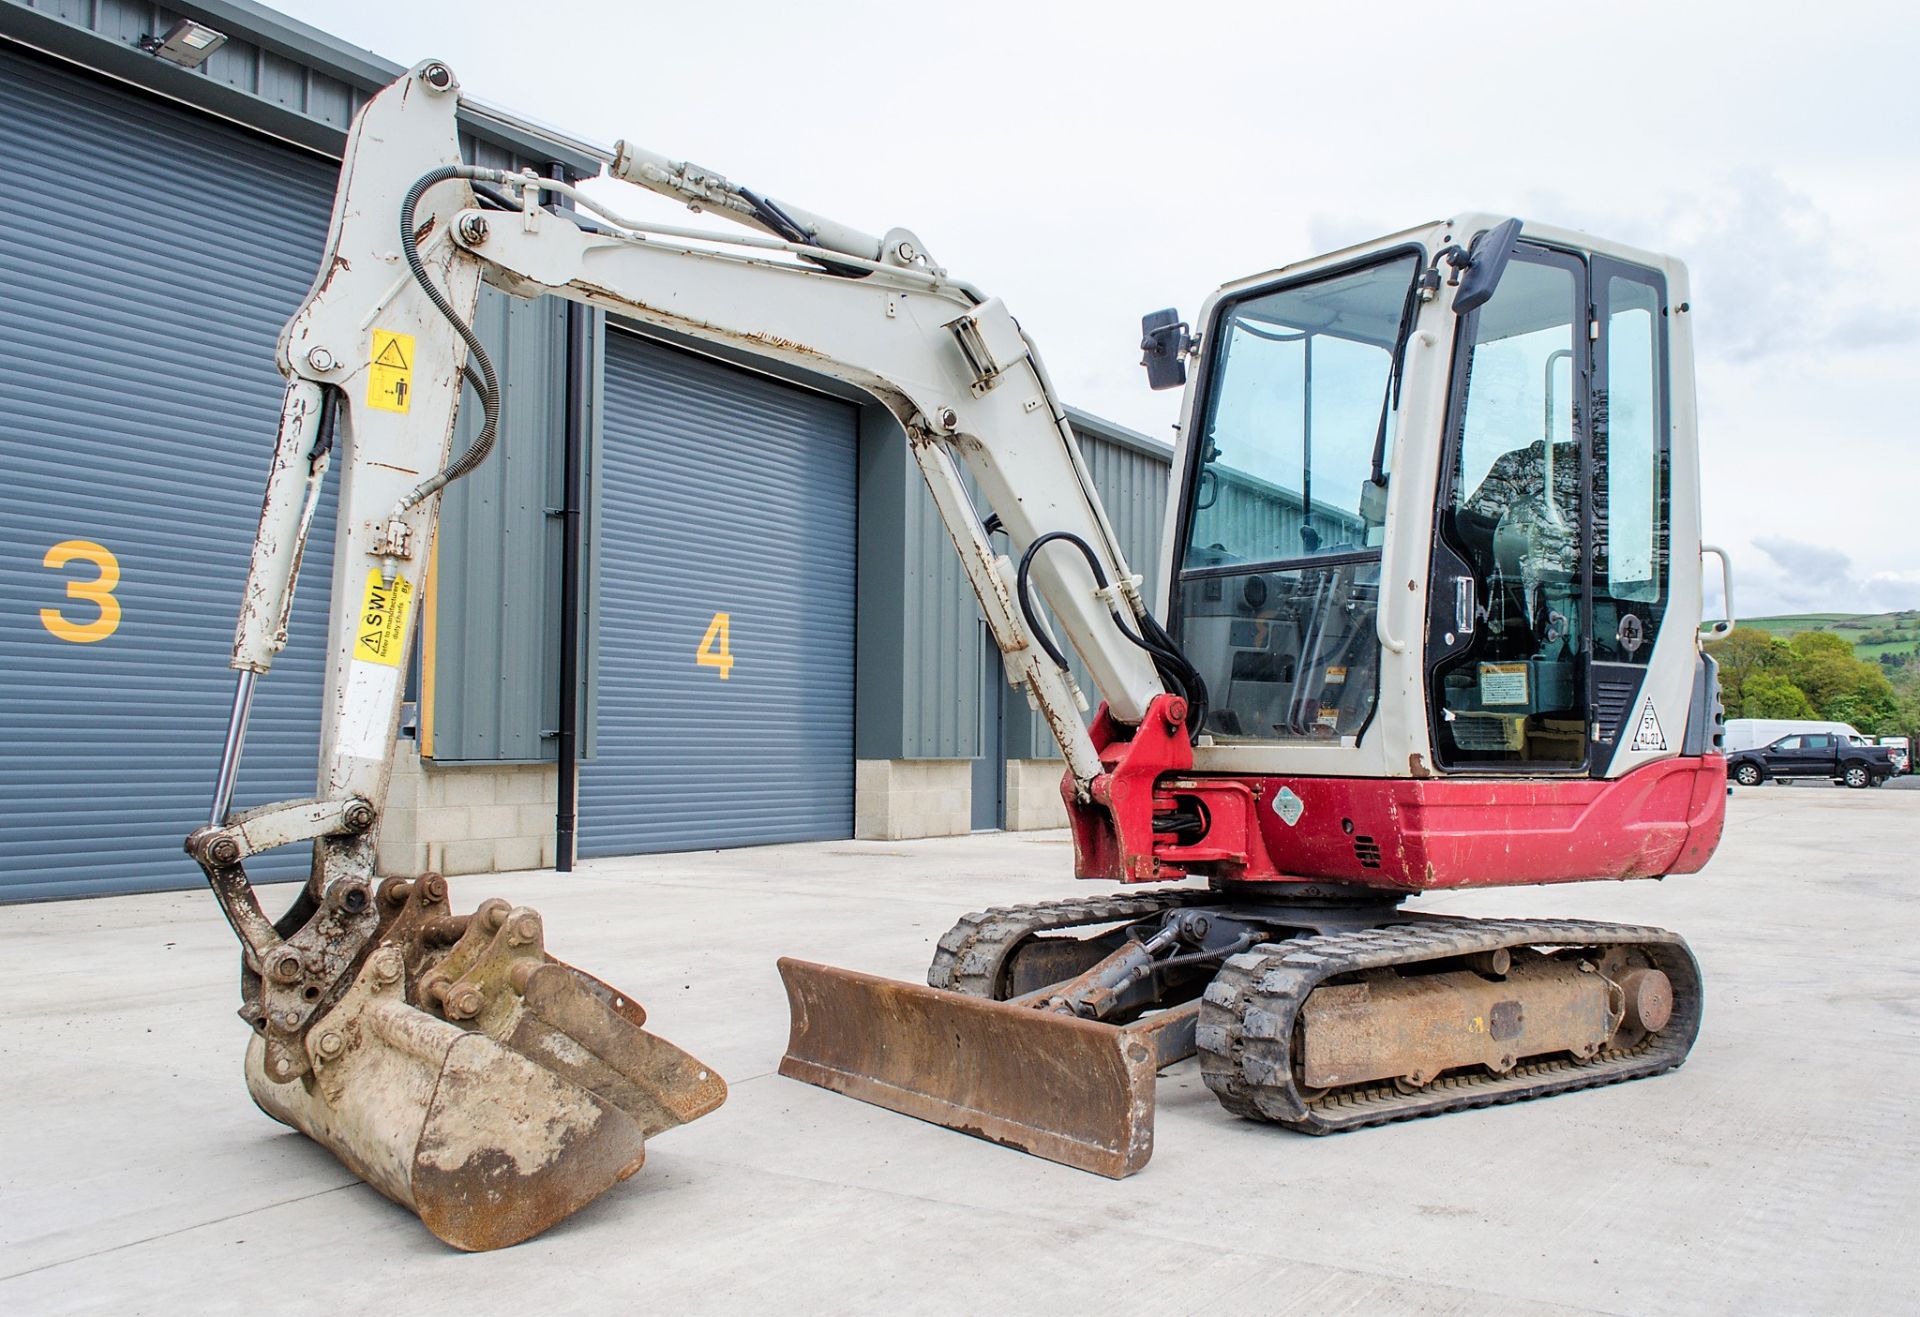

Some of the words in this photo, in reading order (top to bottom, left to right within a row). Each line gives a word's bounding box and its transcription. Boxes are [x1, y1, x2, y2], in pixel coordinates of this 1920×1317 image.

[40, 540, 121, 643] 3
[697, 612, 734, 680] 4
[1645, 718, 1654, 729] 57
